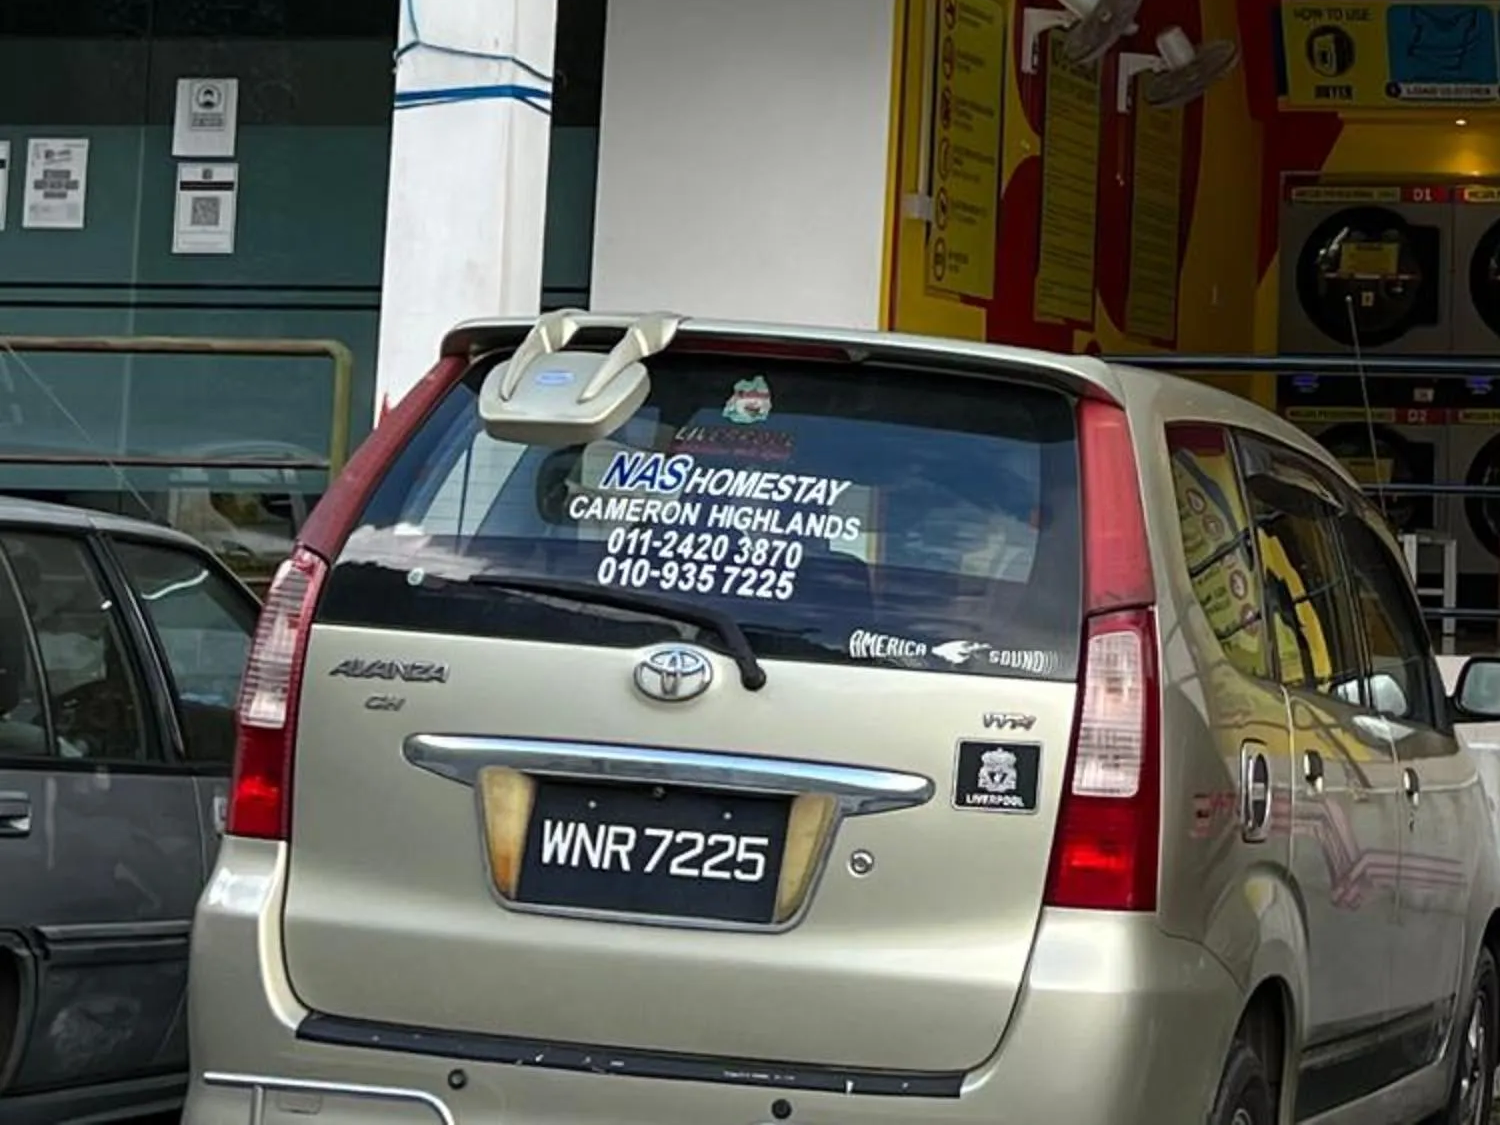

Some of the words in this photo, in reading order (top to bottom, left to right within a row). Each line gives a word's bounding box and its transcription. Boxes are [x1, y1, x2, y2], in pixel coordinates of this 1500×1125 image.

[600, 451, 694, 494] NAS
[684, 467, 851, 506] HOMESTAY
[569, 495, 701, 526] CAMERON
[707, 504, 861, 541] HIGHLANDS
[607, 527, 728, 561] 011-2420
[734, 537, 803, 570] 3870
[597, 556, 716, 594] 010-935
[721, 567, 796, 600] 7225
[850, 630, 927, 659] AMERICA
[540, 818, 635, 873] WNR
[643, 826, 769, 883] 7225
